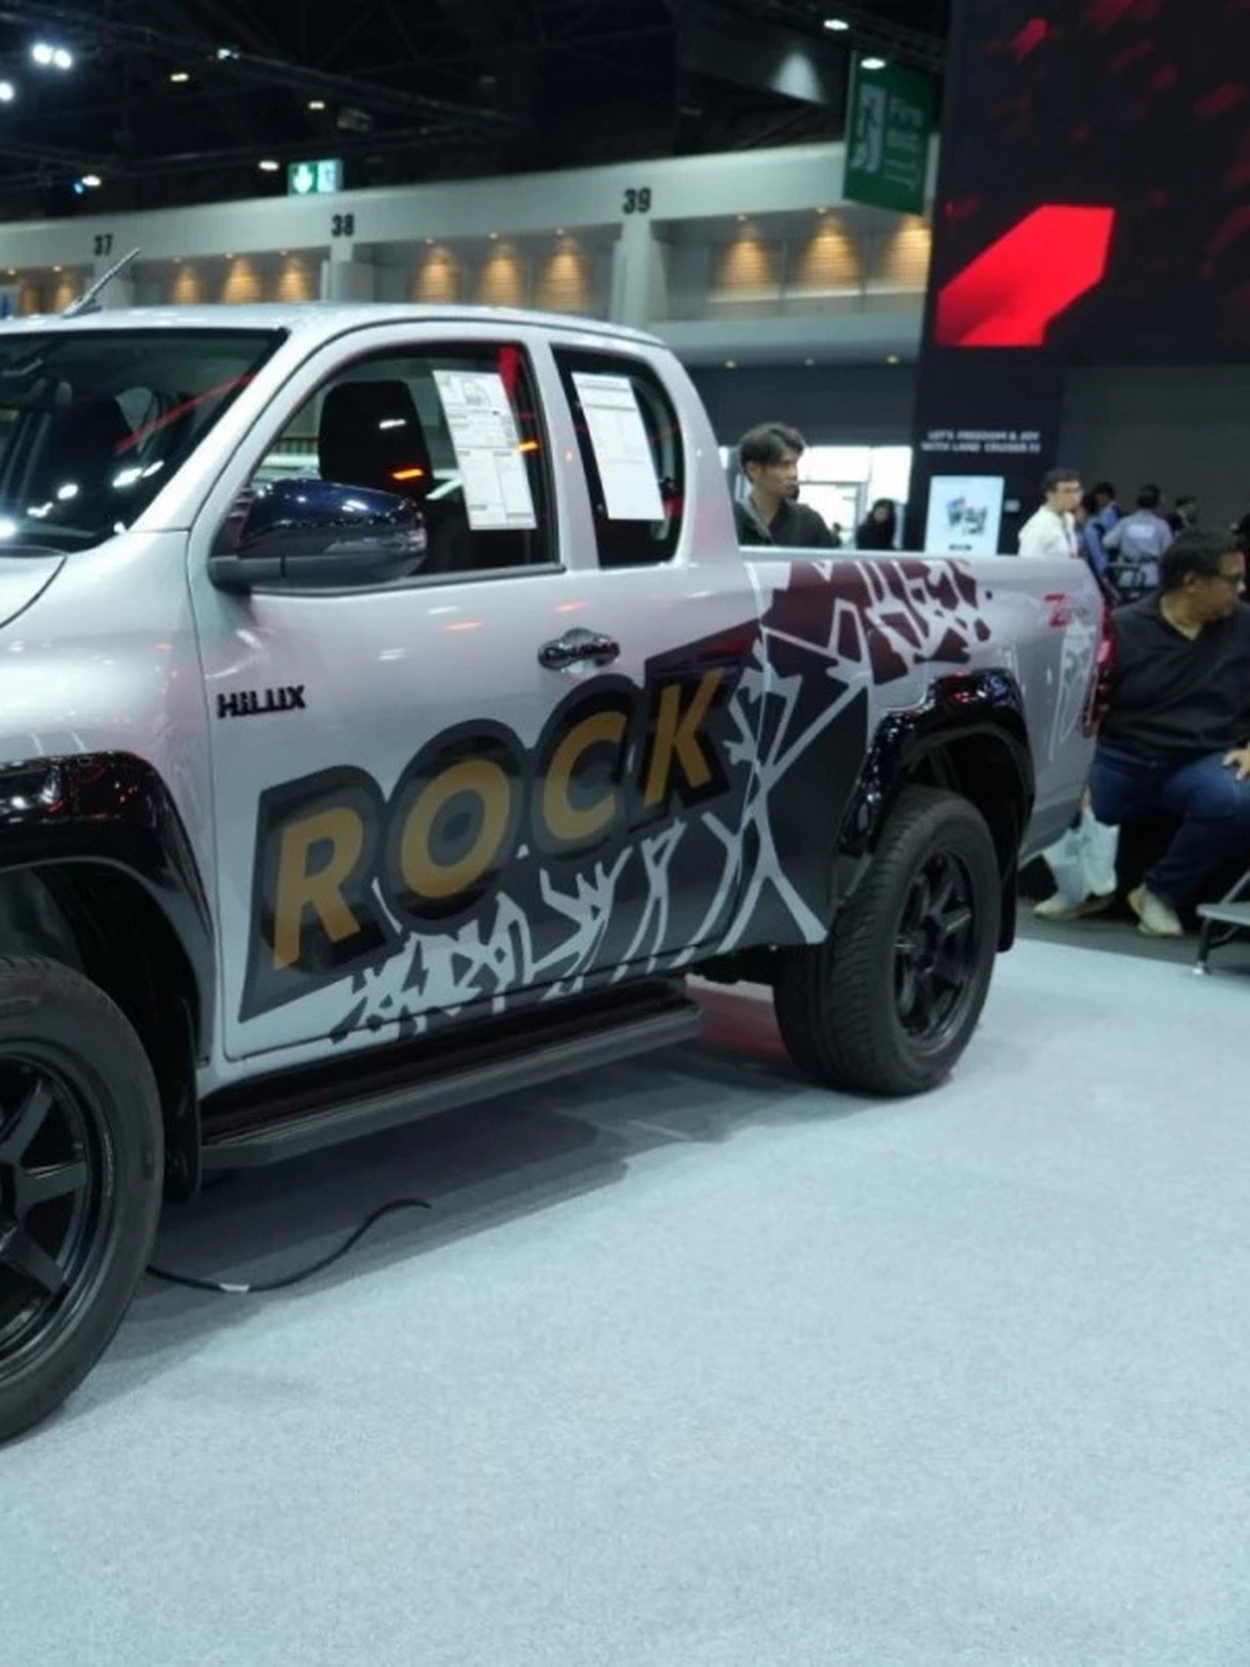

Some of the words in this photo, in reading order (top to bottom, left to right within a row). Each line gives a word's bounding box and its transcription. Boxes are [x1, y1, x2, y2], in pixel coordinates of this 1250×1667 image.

[623, 187, 651, 215] 39
[331, 213, 354, 237] 38
[94, 233, 113, 256] 37
[273, 669, 723, 971] ROCK
